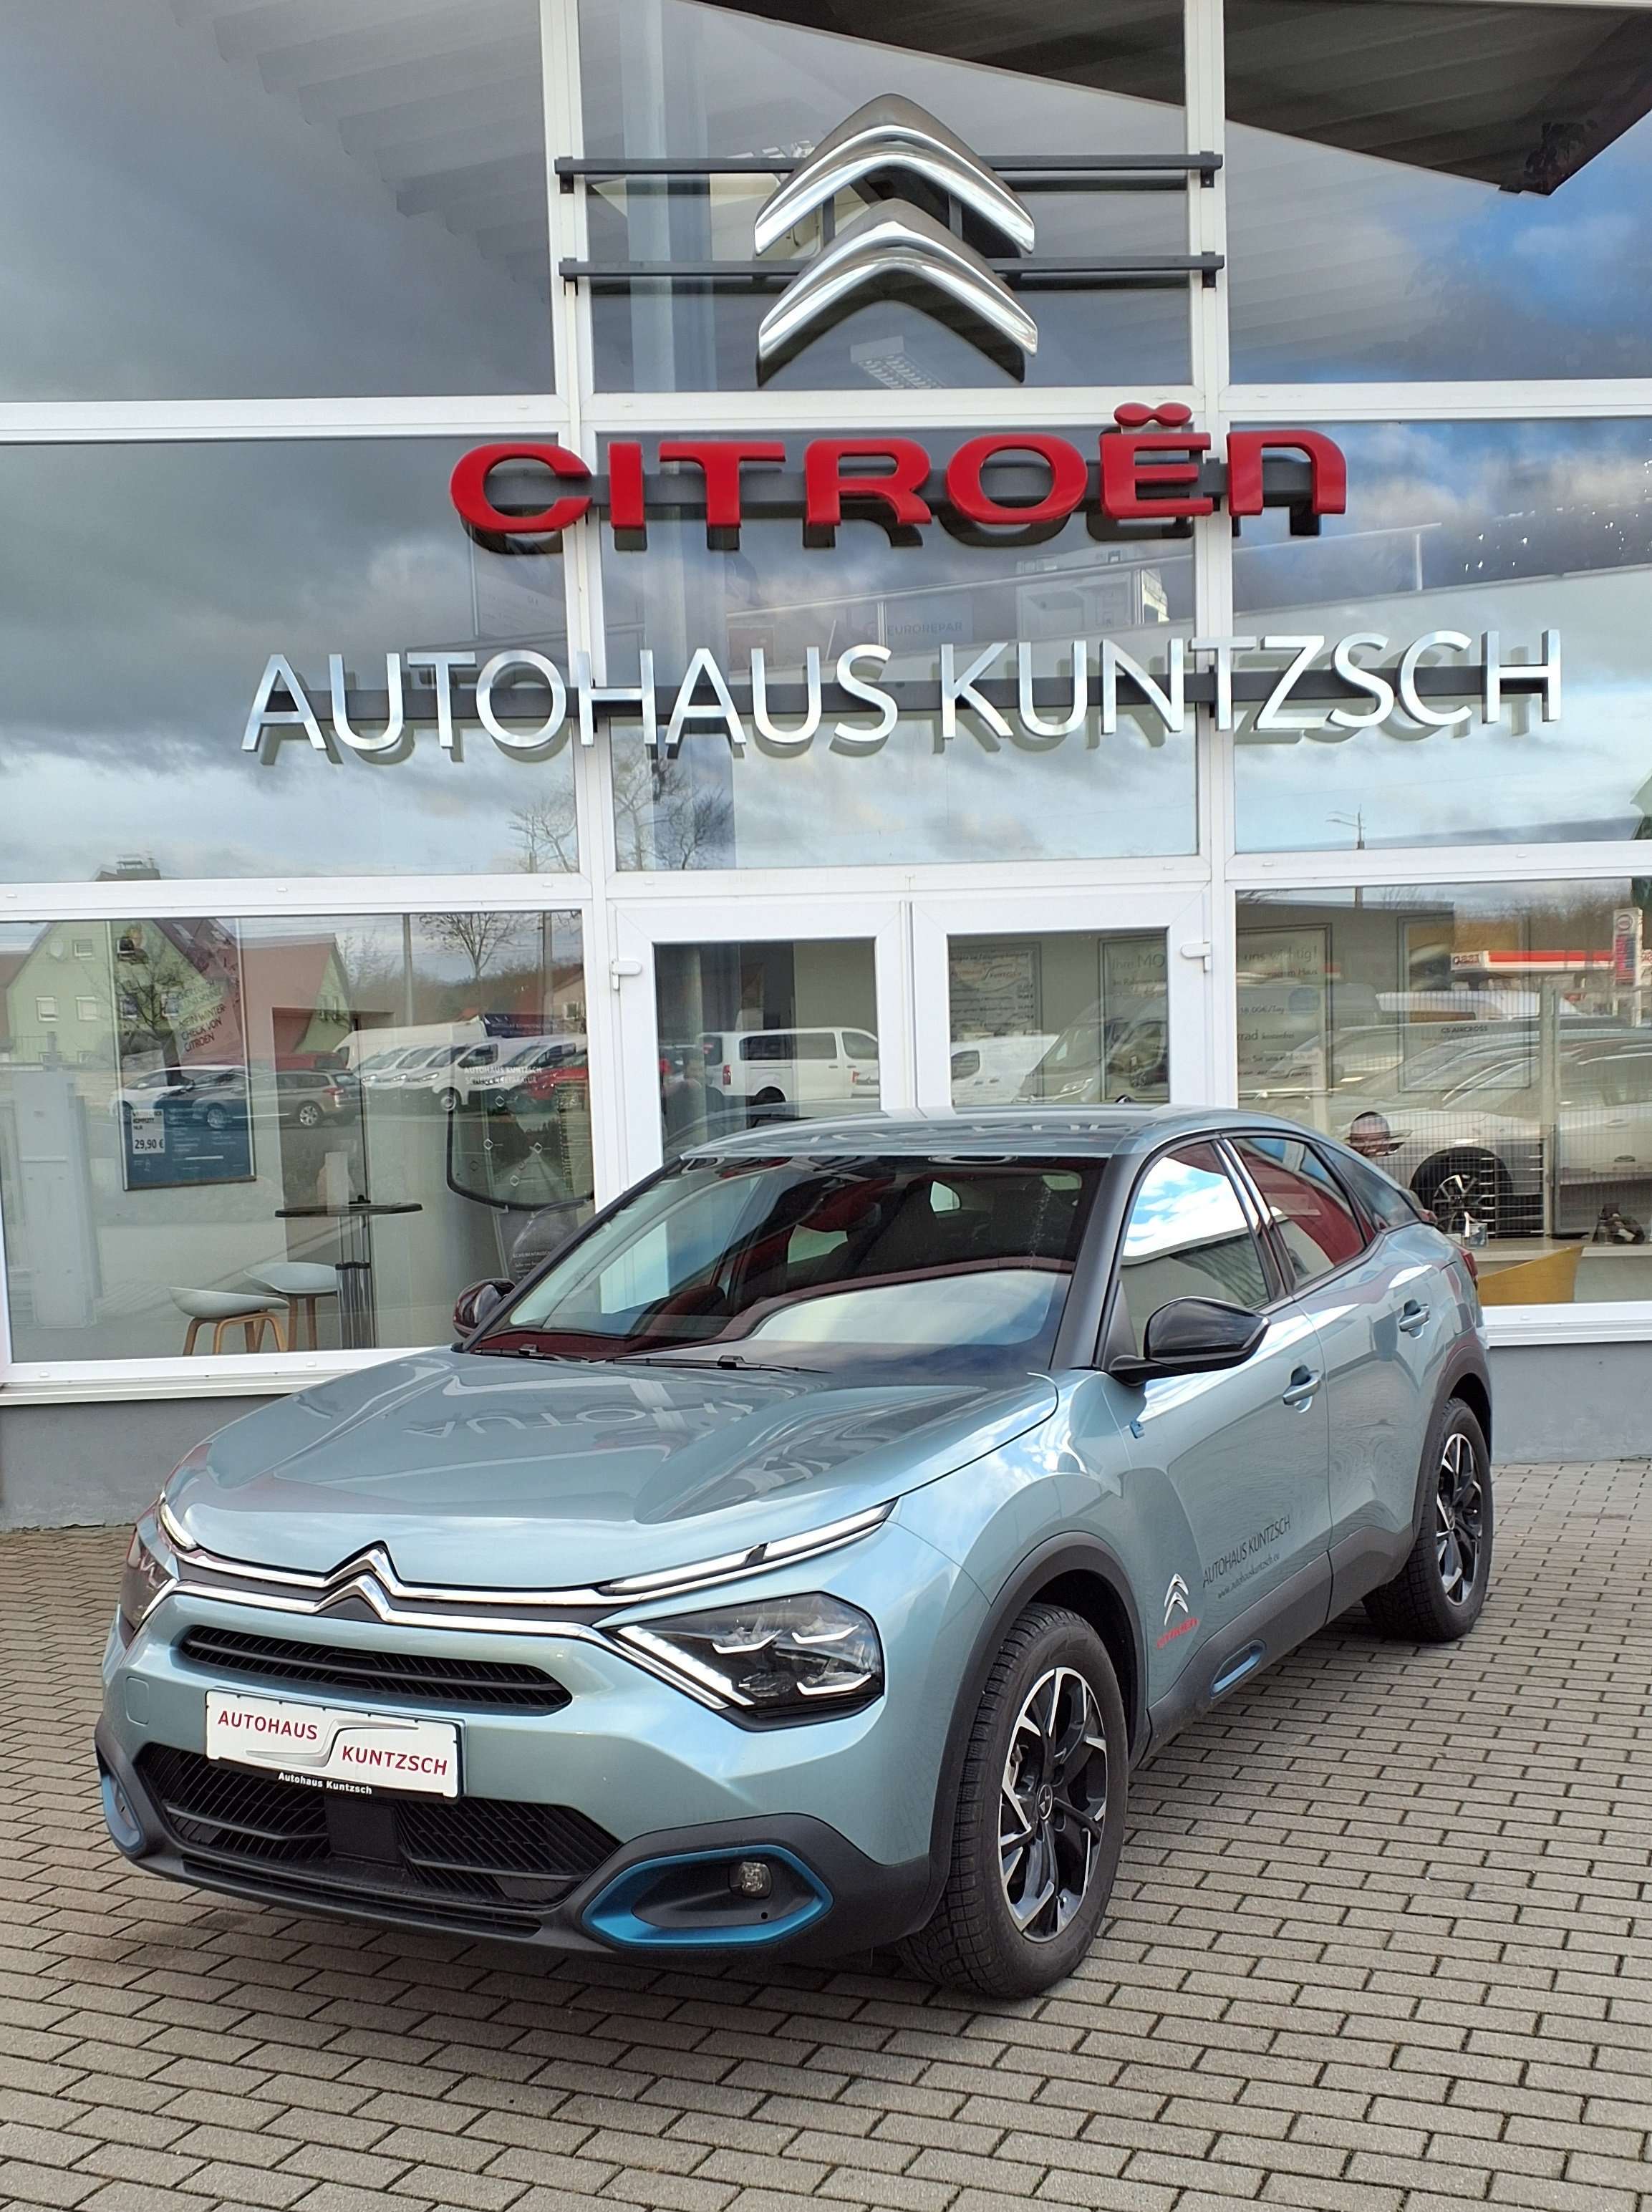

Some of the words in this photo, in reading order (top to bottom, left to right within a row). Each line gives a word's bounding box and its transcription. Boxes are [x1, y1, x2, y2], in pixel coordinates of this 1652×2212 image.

[450, 402, 1346, 533] CITROËN
[241, 644, 898, 752] AUTOHAUS
[939, 629, 1562, 739] KUNTZSCH
[1137, 953, 1166, 968] MO
[1451, 1025, 1488, 1033] AIRCROSS
[135, 1139, 156, 1150] 29,90
[1203, 1542, 1247, 1588] AUTOHAUS
[1248, 1514, 1291, 1557] KUNTZSCH
[217, 1710, 319, 1741] AUTOHAUS
[342, 1744, 448, 1776] KUNTZSCH
[278, 1772, 324, 1788] Autohaus
[326, 1779, 373, 1795] Kuntzsch
